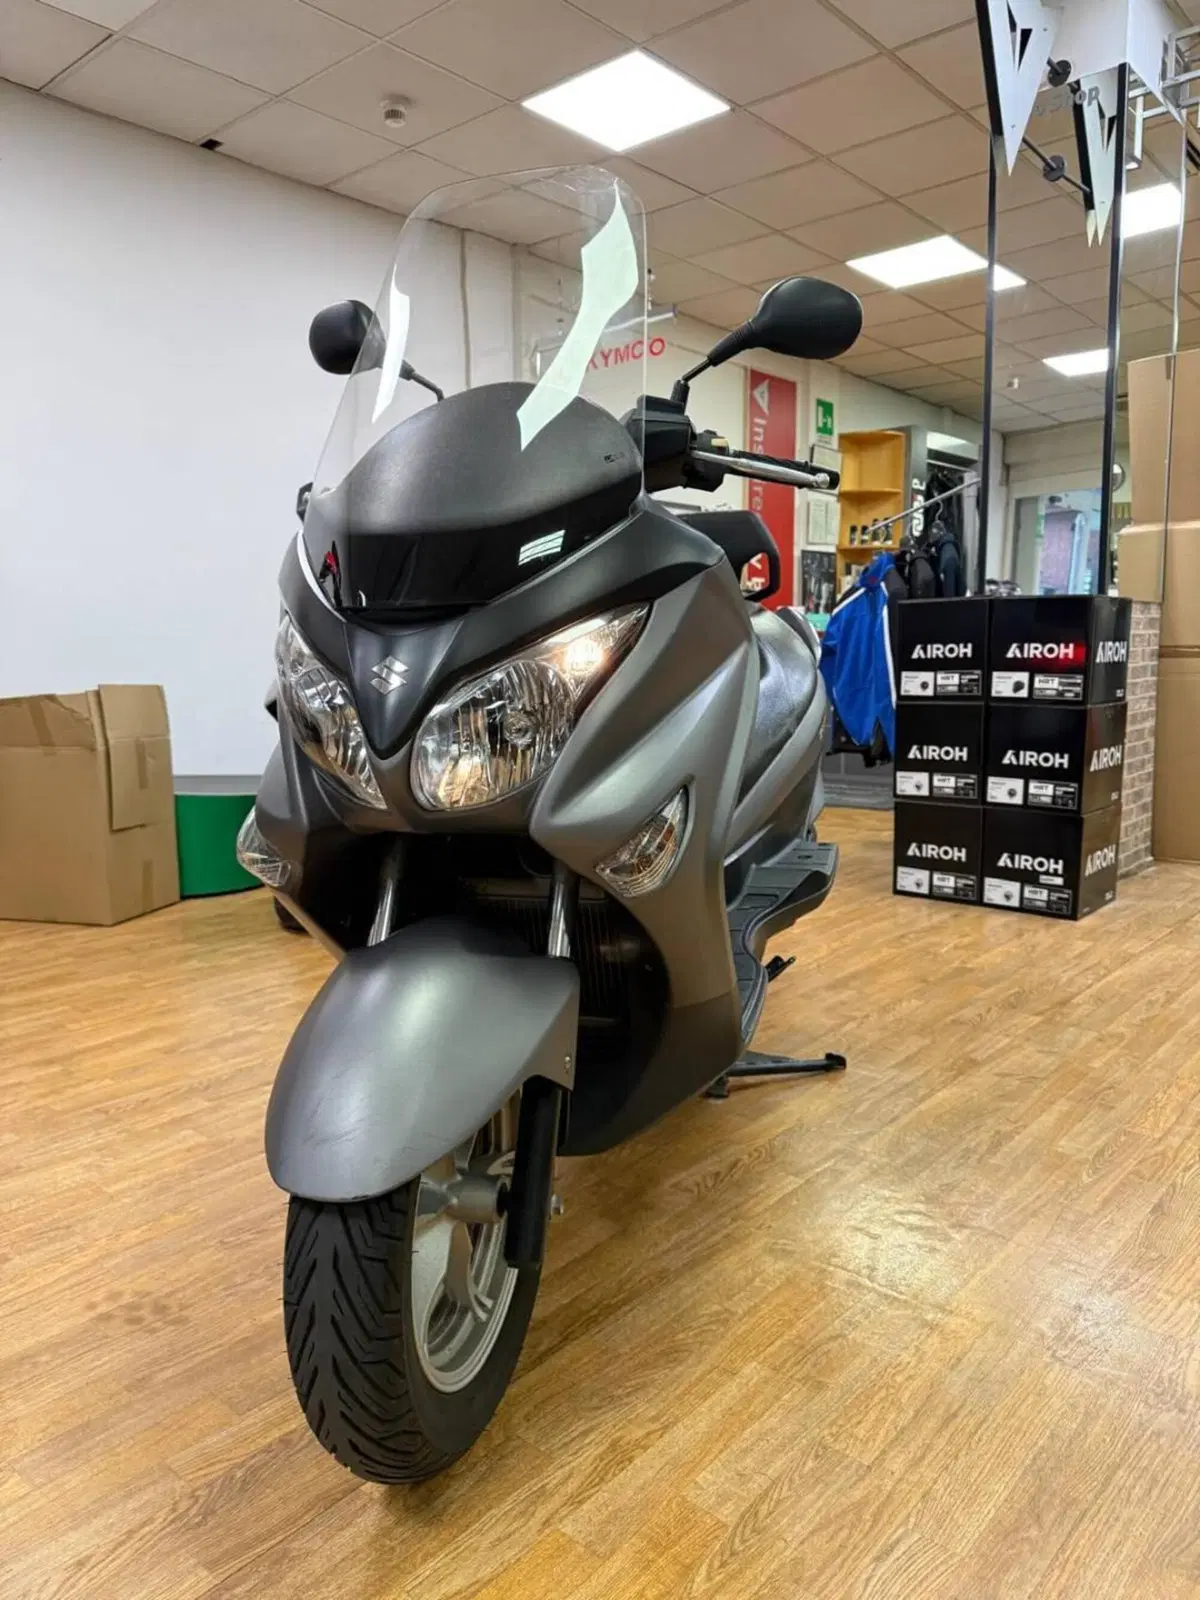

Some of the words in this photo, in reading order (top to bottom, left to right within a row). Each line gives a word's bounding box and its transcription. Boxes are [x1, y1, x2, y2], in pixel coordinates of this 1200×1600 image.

[911, 643, 973, 659] AIROH
[1006, 643, 1074, 659] AIROH
[1096, 641, 1128, 663] AIROH
[907, 745, 968, 761] AIROH
[1002, 750, 1069, 769] AIROH
[1089, 745, 1123, 772] AIROH
[907, 843, 967, 862] AIROH
[1085, 844, 1117, 877] AIROH
[997, 853, 1064, 875] AIROH
